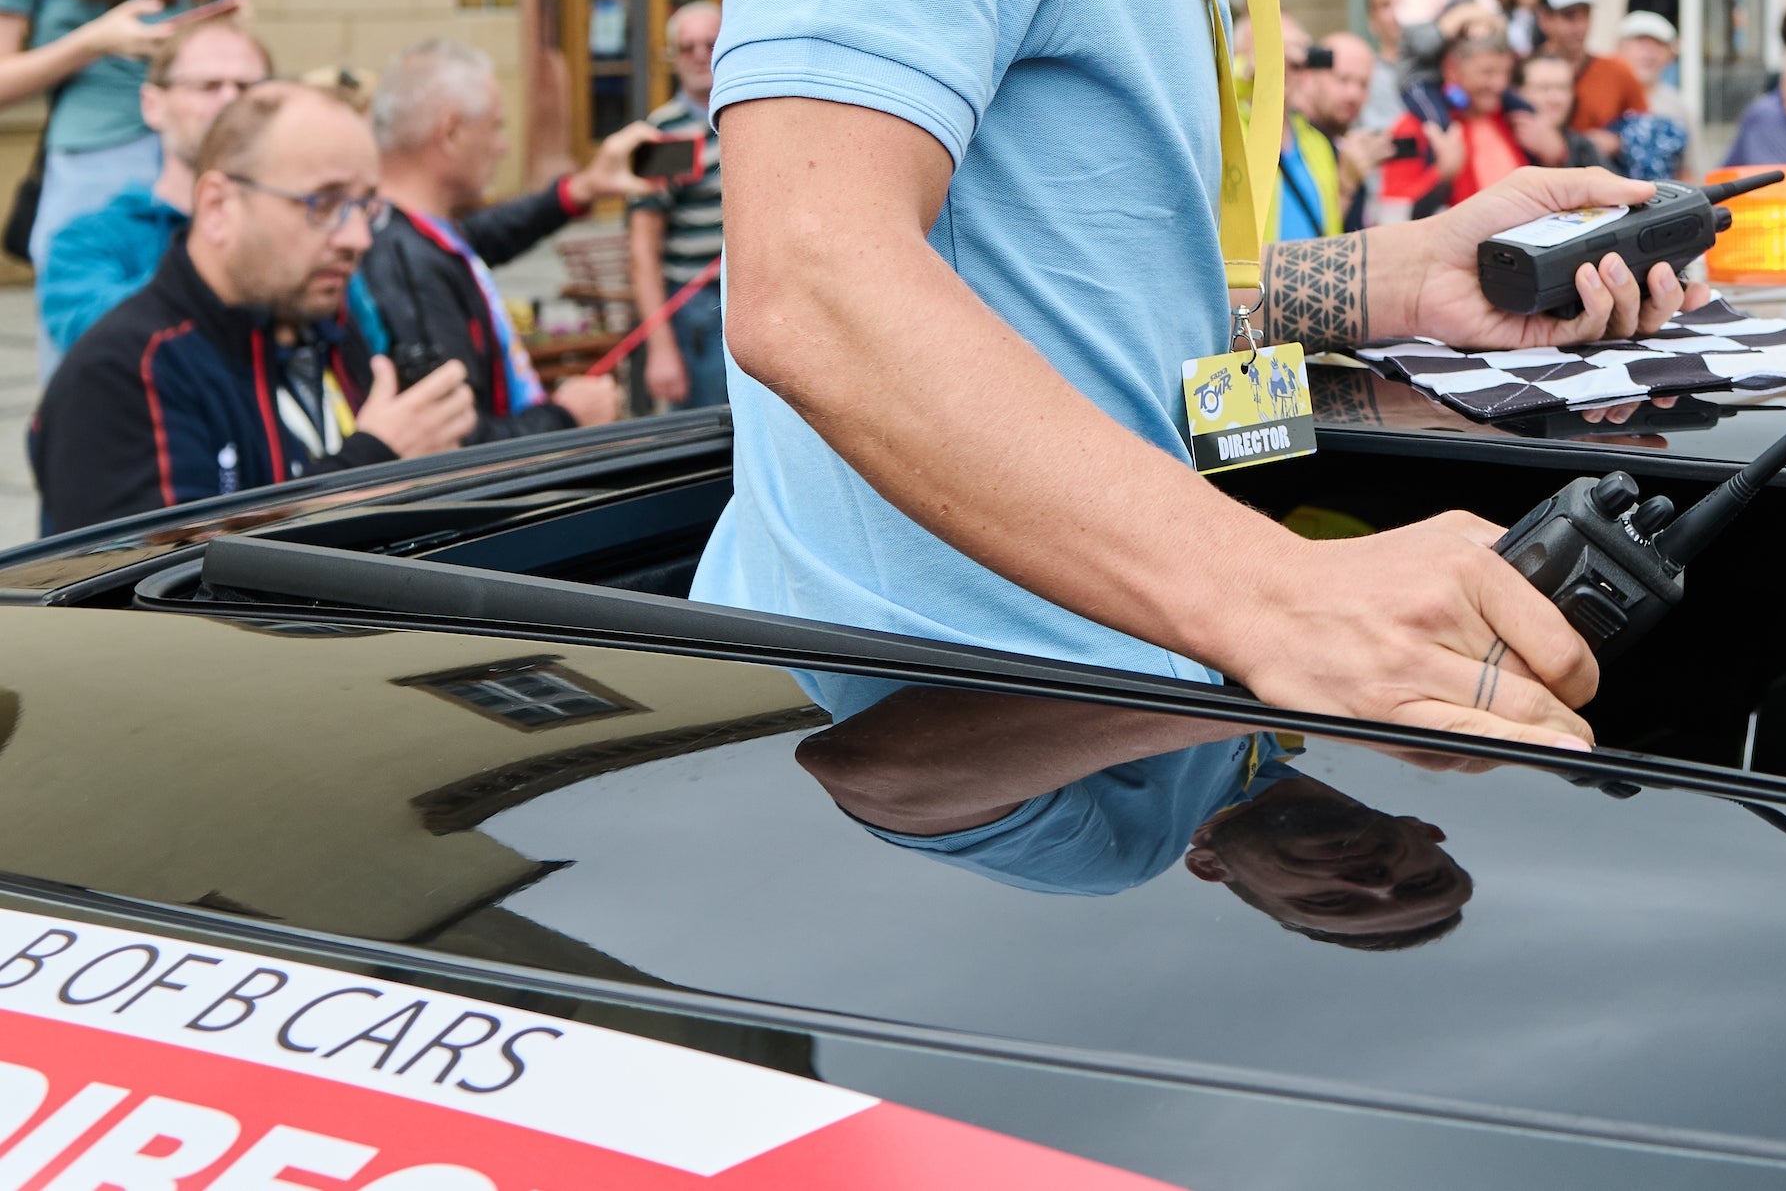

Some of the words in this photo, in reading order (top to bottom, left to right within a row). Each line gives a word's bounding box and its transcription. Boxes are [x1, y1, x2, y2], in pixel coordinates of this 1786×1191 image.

[1193, 373, 1233, 414] TOUR
[1217, 424, 1291, 461] DIRECTOR
[57, 943, 224, 1015] OF
[184, 967, 290, 1033] B
[276, 986, 565, 1094] CARS
